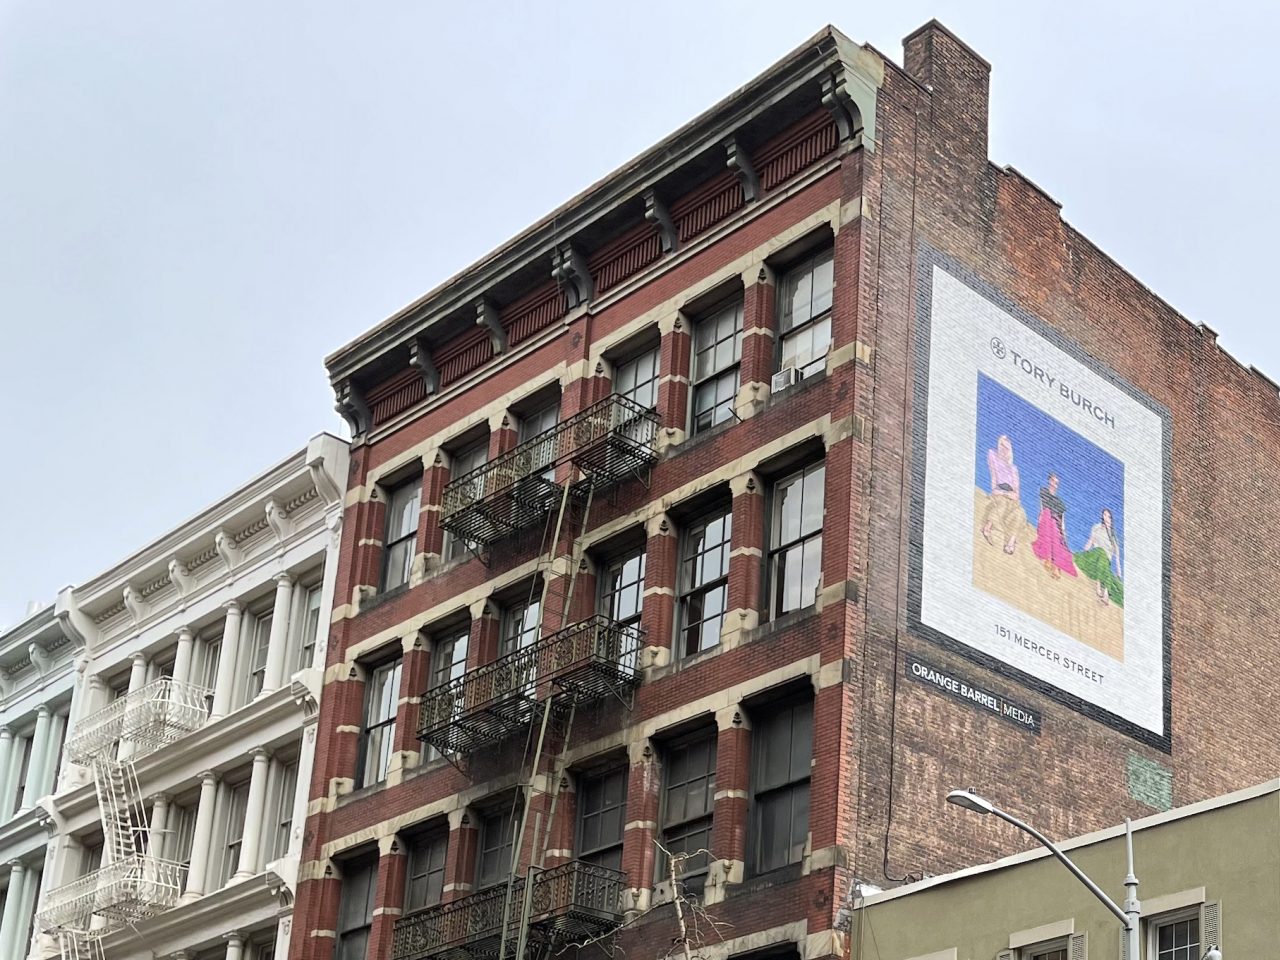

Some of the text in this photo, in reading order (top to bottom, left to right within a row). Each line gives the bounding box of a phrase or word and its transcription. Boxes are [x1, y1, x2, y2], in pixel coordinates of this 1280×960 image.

[1010, 350, 1115, 429] TORY BURCH
[995, 624, 1104, 685] 151 MERCER STREET
[912, 662, 1035, 726] ORANGE BARREL MEDIA
